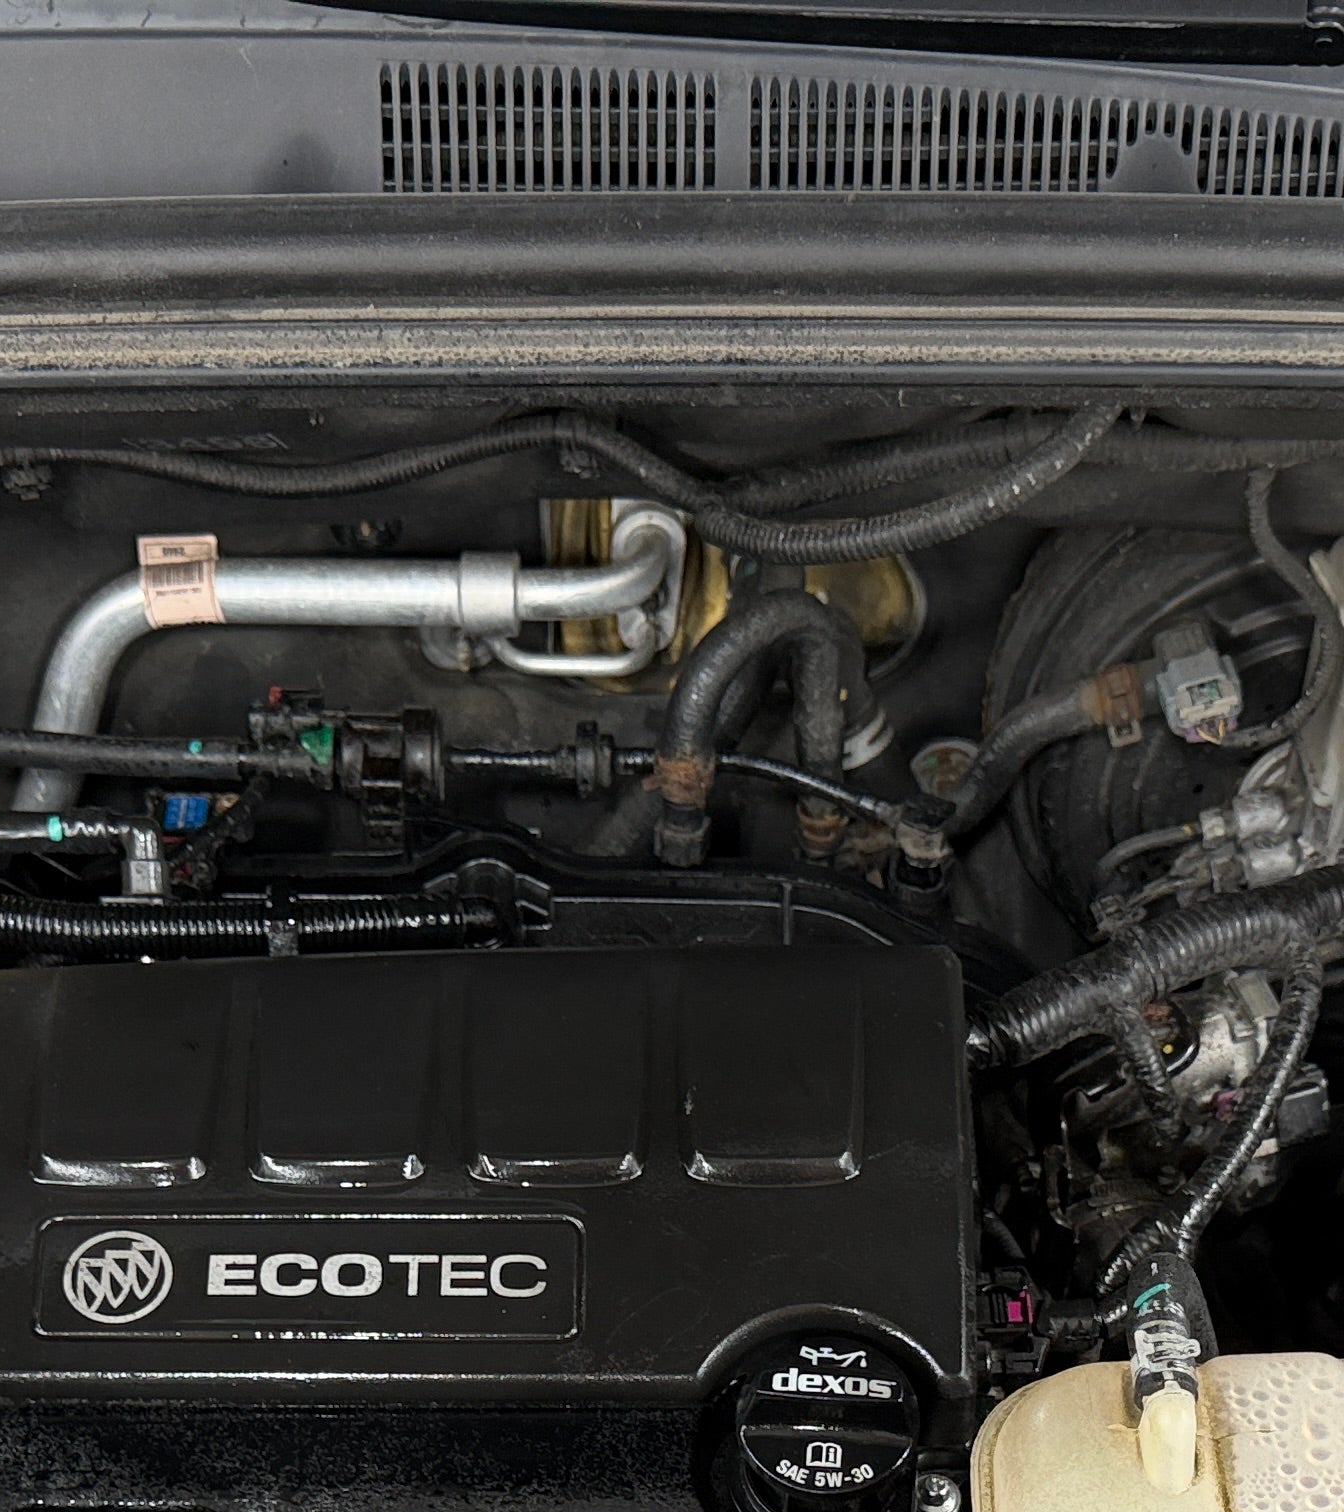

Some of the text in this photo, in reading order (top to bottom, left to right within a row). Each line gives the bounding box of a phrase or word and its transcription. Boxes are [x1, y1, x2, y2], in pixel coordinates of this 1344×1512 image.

[207, 1253, 548, 1298] ECOTEC
[771, 1367, 893, 1399] dexos
[775, 1459, 875, 1488] SAE 5W-30
